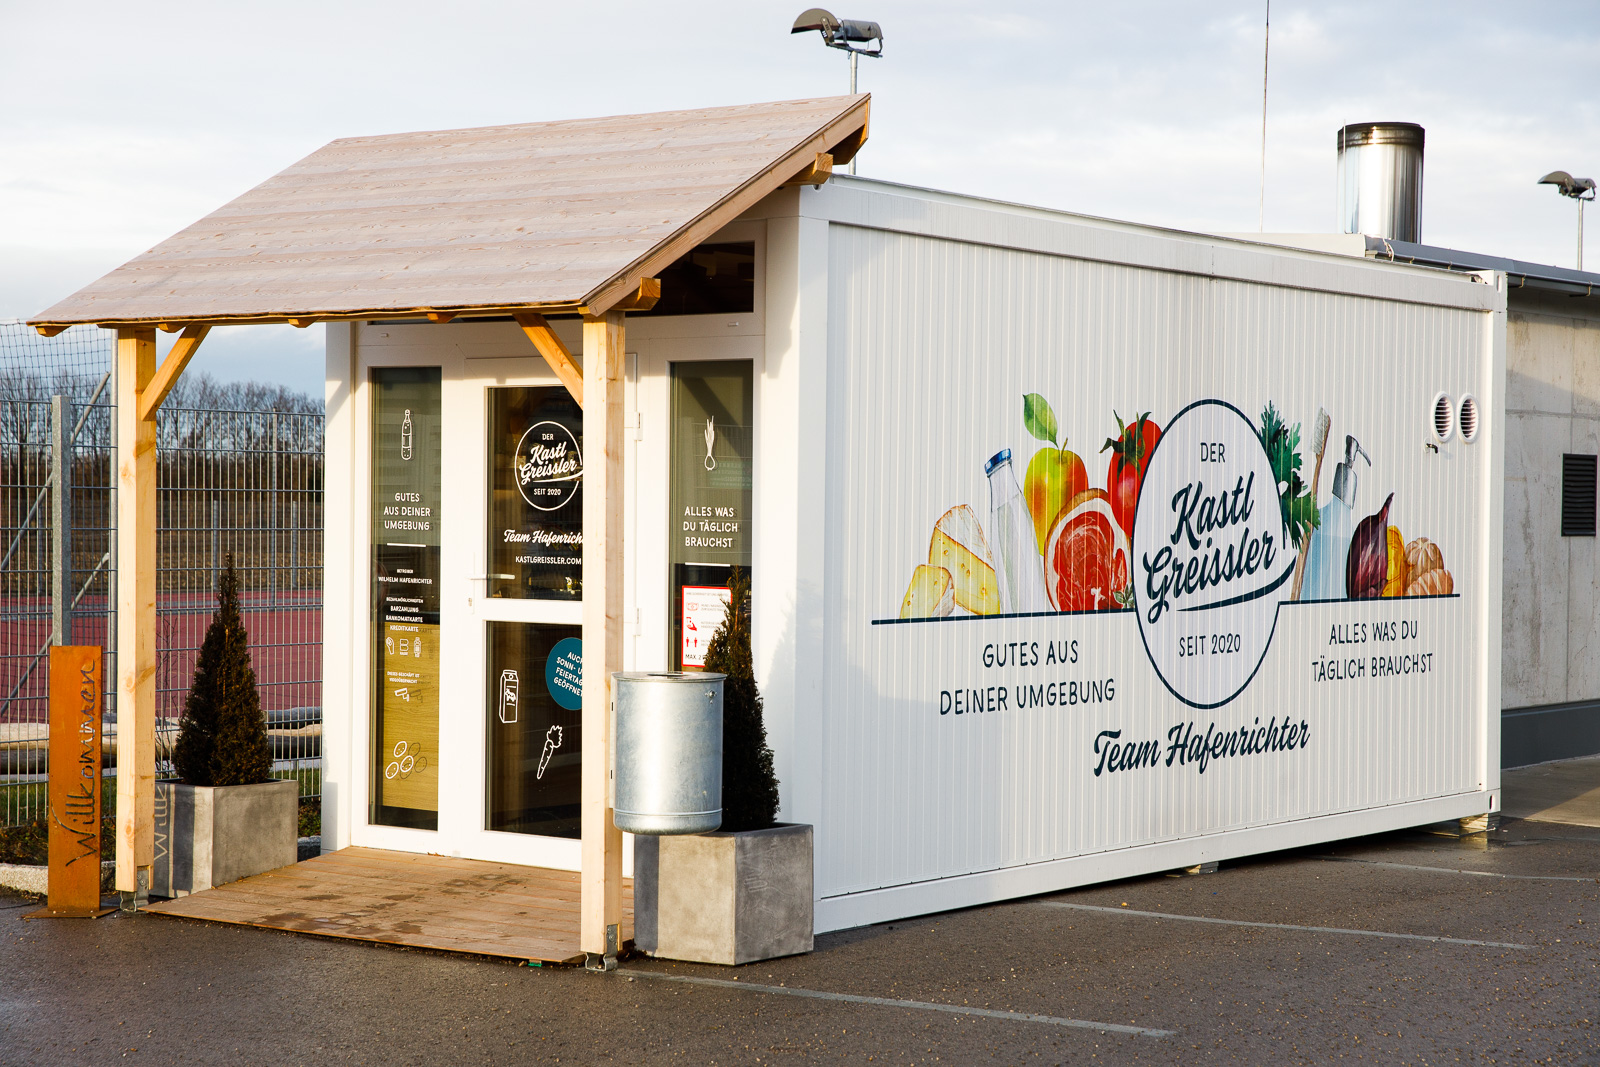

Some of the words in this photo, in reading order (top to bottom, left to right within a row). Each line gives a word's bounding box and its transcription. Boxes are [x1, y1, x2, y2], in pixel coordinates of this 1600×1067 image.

[541, 433, 554, 441] DER
[530, 441, 567, 465] Kastl
[1200, 442, 1226, 463] DER
[519, 458, 577, 485] Greissler
[394, 492, 420, 503] GUTES
[533, 488, 546, 496] SEIT
[547, 488, 562, 496] 2020
[383, 505, 400, 516] AUS
[401, 506, 431, 517] DEINER
[684, 506, 712, 517] ALLES
[714, 507, 734, 518] WAS
[1170, 470, 1255, 551] Kastl
[384, 520, 430, 531] UMGEBUNG
[682, 521, 696, 531] DU
[698, 519, 738, 533] TÄGLICH
[503, 529, 531, 543] Team
[531, 530, 583, 547] Hafenrich
[684, 536, 733, 548] BRAUCHST
[515, 555, 582, 565] KASTLGREISSLER.COM
[1142, 527, 1277, 624] Greissler
[1329, 623, 1367, 645] ALLES
[1372, 621, 1397, 642] WAS
[1401, 620, 1418, 640] DU
[982, 643, 1039, 668] GUTES
[1046, 639, 1079, 666] AUS
[1178, 635, 1206, 657] SEIT
[1211, 633, 1241, 655] 2020
[556, 656, 577, 671] SONN-
[1312, 655, 1366, 682] TÄGLICH
[1371, 653, 1433, 678] BRAUCHST
[555, 666, 583, 686] FEIERTAG
[940, 686, 1008, 716] DEINER
[1016, 678, 1115, 709] UMGEBUNG
[1093, 729, 1162, 777] Team
[1165, 715, 1311, 775] Hafenrichter
[51, 659, 97, 867] Willkommen
